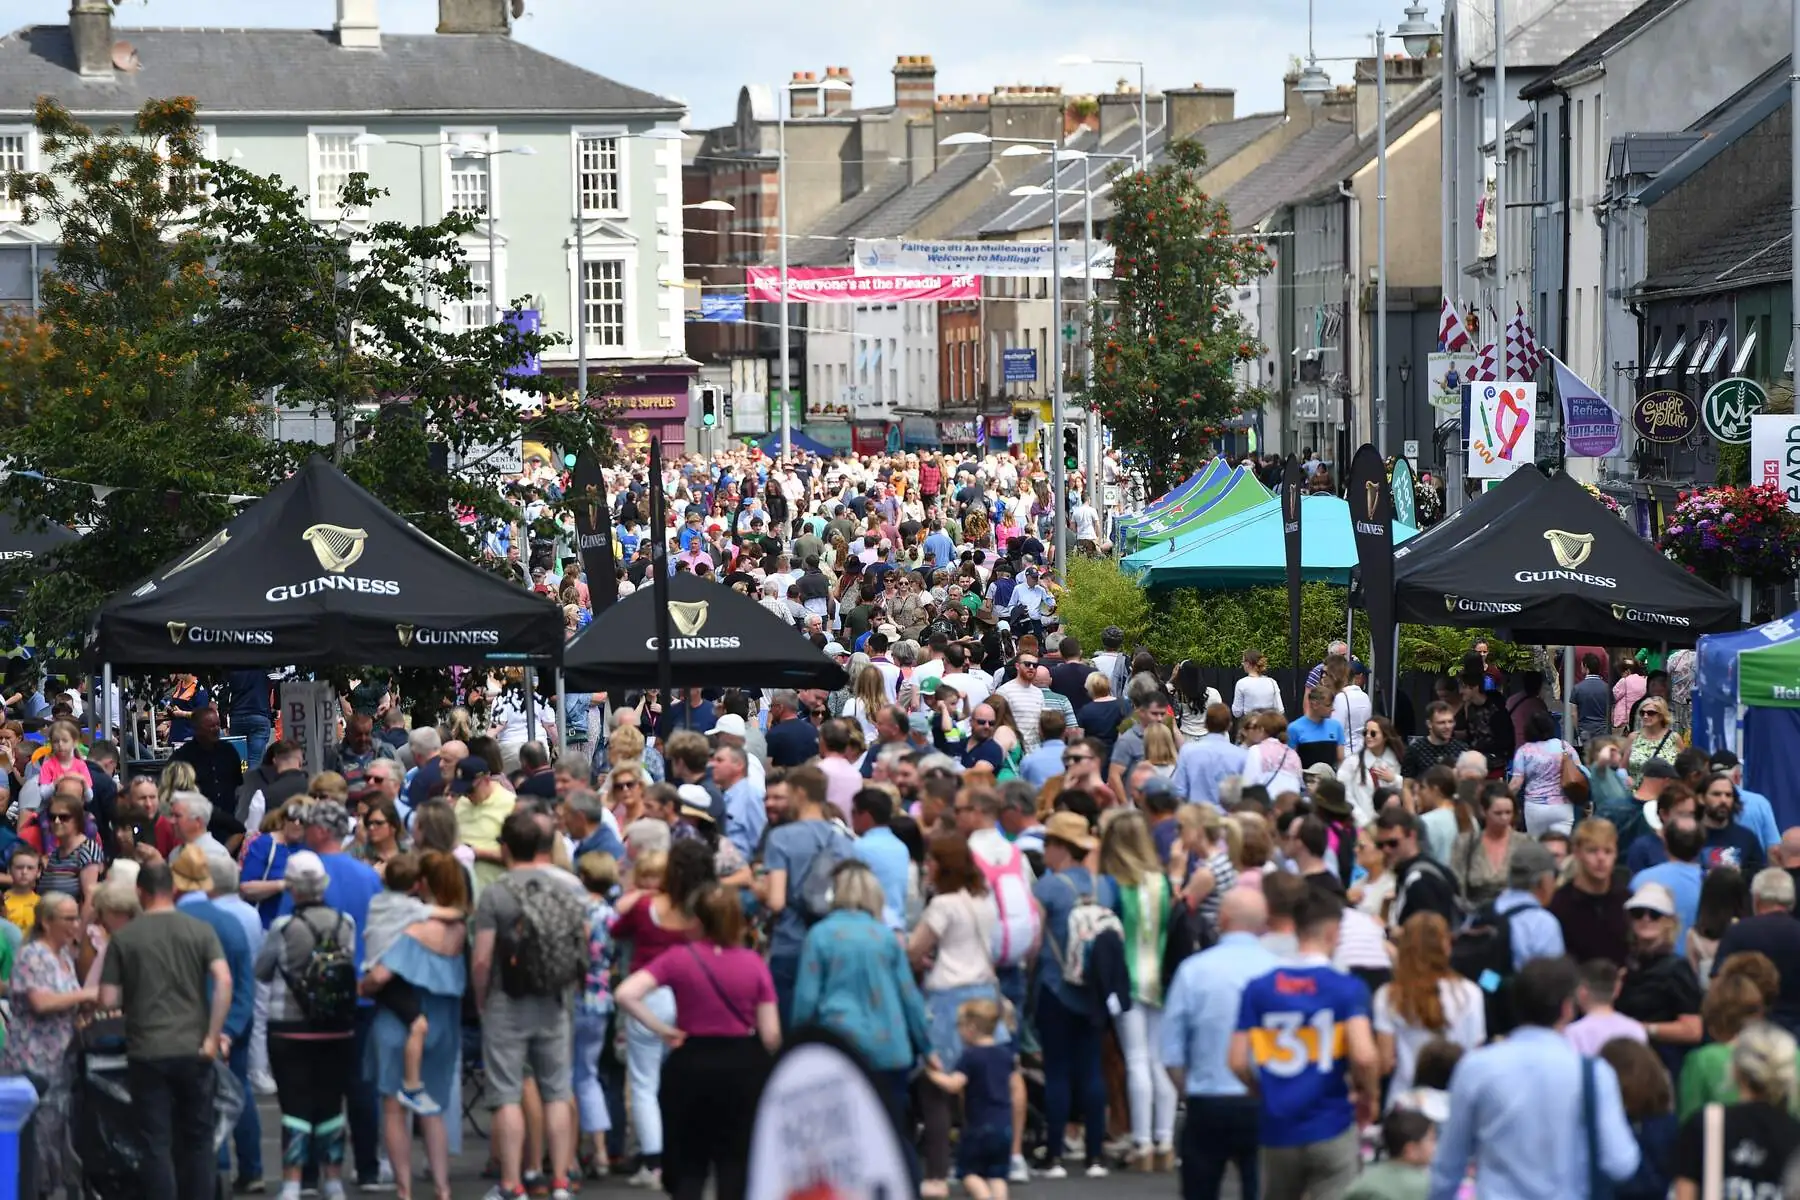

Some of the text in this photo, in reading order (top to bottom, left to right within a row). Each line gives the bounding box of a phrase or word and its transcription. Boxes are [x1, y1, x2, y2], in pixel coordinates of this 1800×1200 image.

[931, 245, 945, 253] go
[1033, 245, 1069, 254] gCerr
[928, 254, 1041, 264] Welcome to Mullingar
[788, 278, 857, 291] Everyone's
[859, 280, 871, 289] at
[873, 279, 893, 289] the
[638, 396, 677, 408] SUPPLIES
[1572, 405, 1608, 416] Reflect
[1568, 425, 1616, 437] AUTO-CARE
[1357, 520, 1384, 535] GUINNESS
[1514, 570, 1616, 589] GUINNESS
[265, 575, 401, 602] GUINNESS
[1458, 599, 1522, 613] GUINNESS
[1626, 609, 1690, 627] GUINNESS
[188, 626, 273, 644] GUINNESS
[416, 628, 499, 644] GUINNESS
[1262, 1007, 1335, 1078] 31
